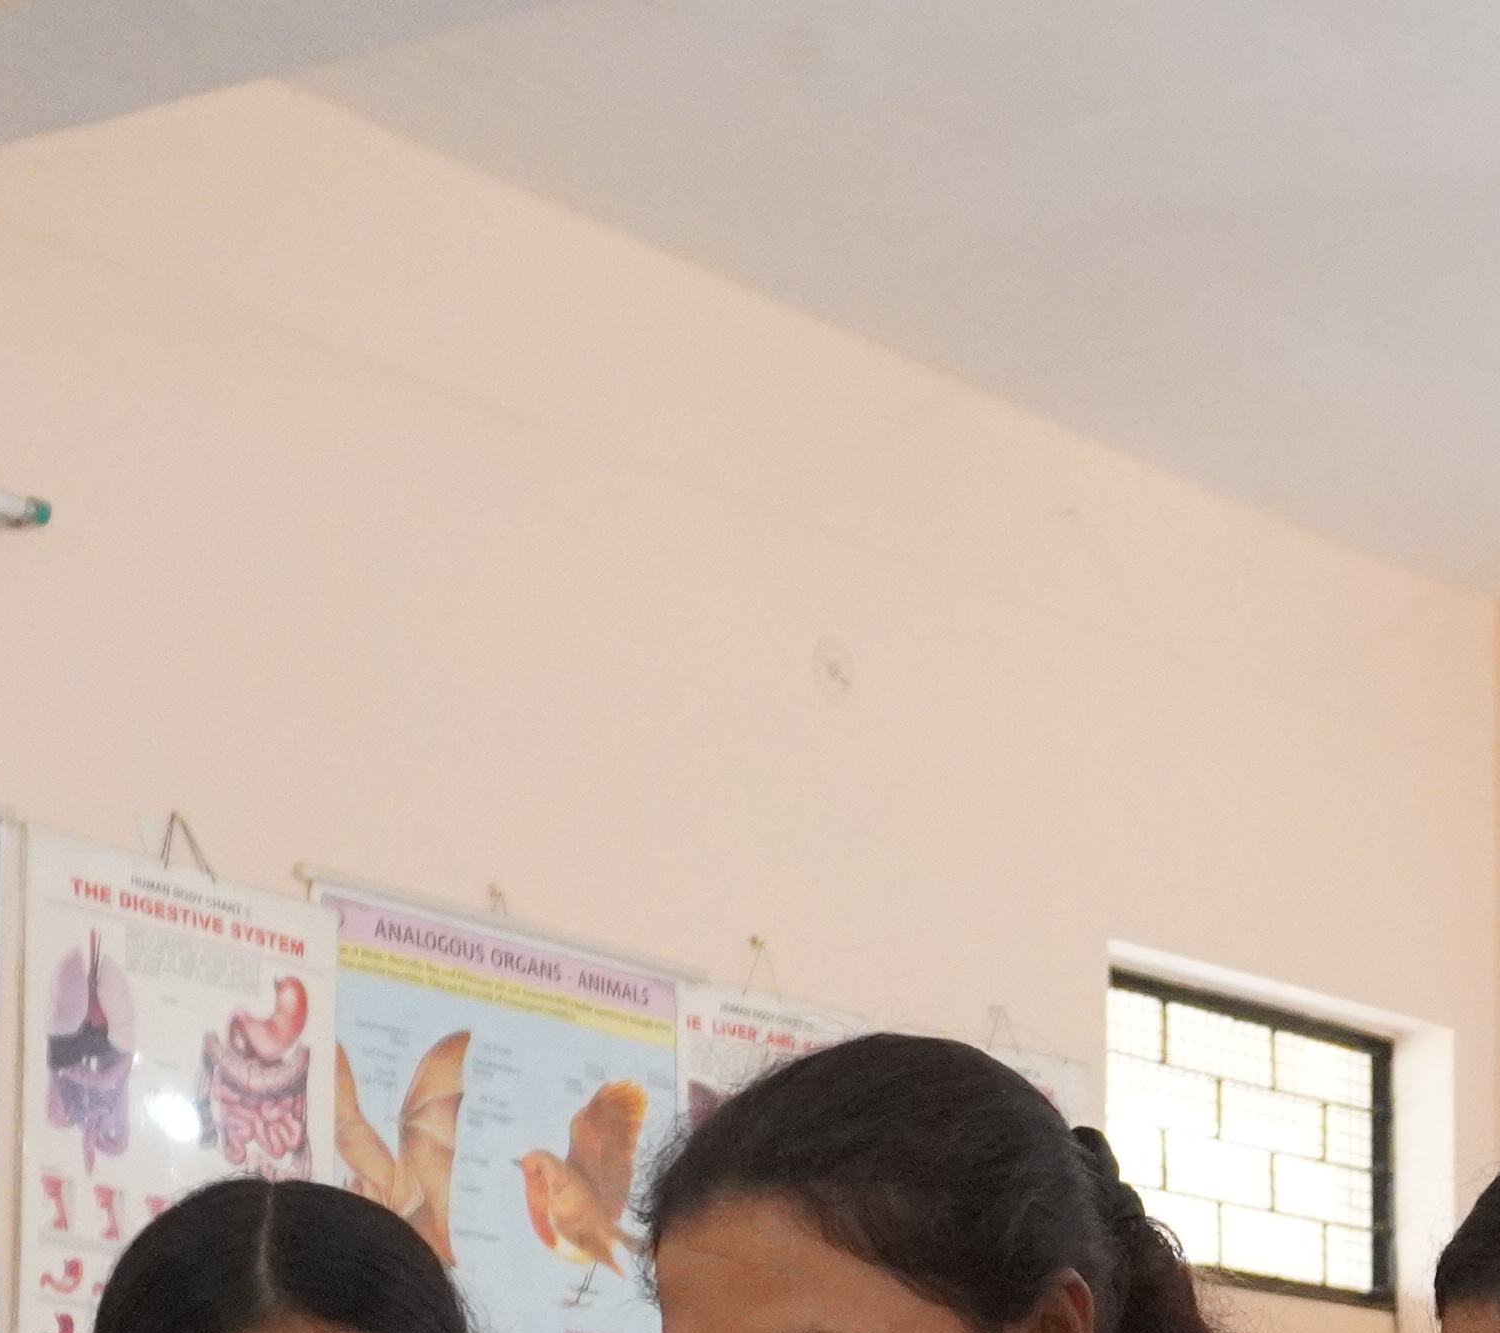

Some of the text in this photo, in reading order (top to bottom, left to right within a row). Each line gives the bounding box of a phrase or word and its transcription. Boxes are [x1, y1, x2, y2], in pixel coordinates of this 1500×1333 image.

[71, 877, 305, 958] THE DIGESTIVE SYSTEM
[131, 875, 170, 897] HUMAN
[173, 887, 201, 904] BODY
[205, 896, 241, 916] CHART
[374, 918, 484, 964] ANALOGOUS
[491, 949, 561, 982] ORGANS
[577, 970, 649, 1006] ANIMALS
[712, 1020, 757, 1041] LIVER
